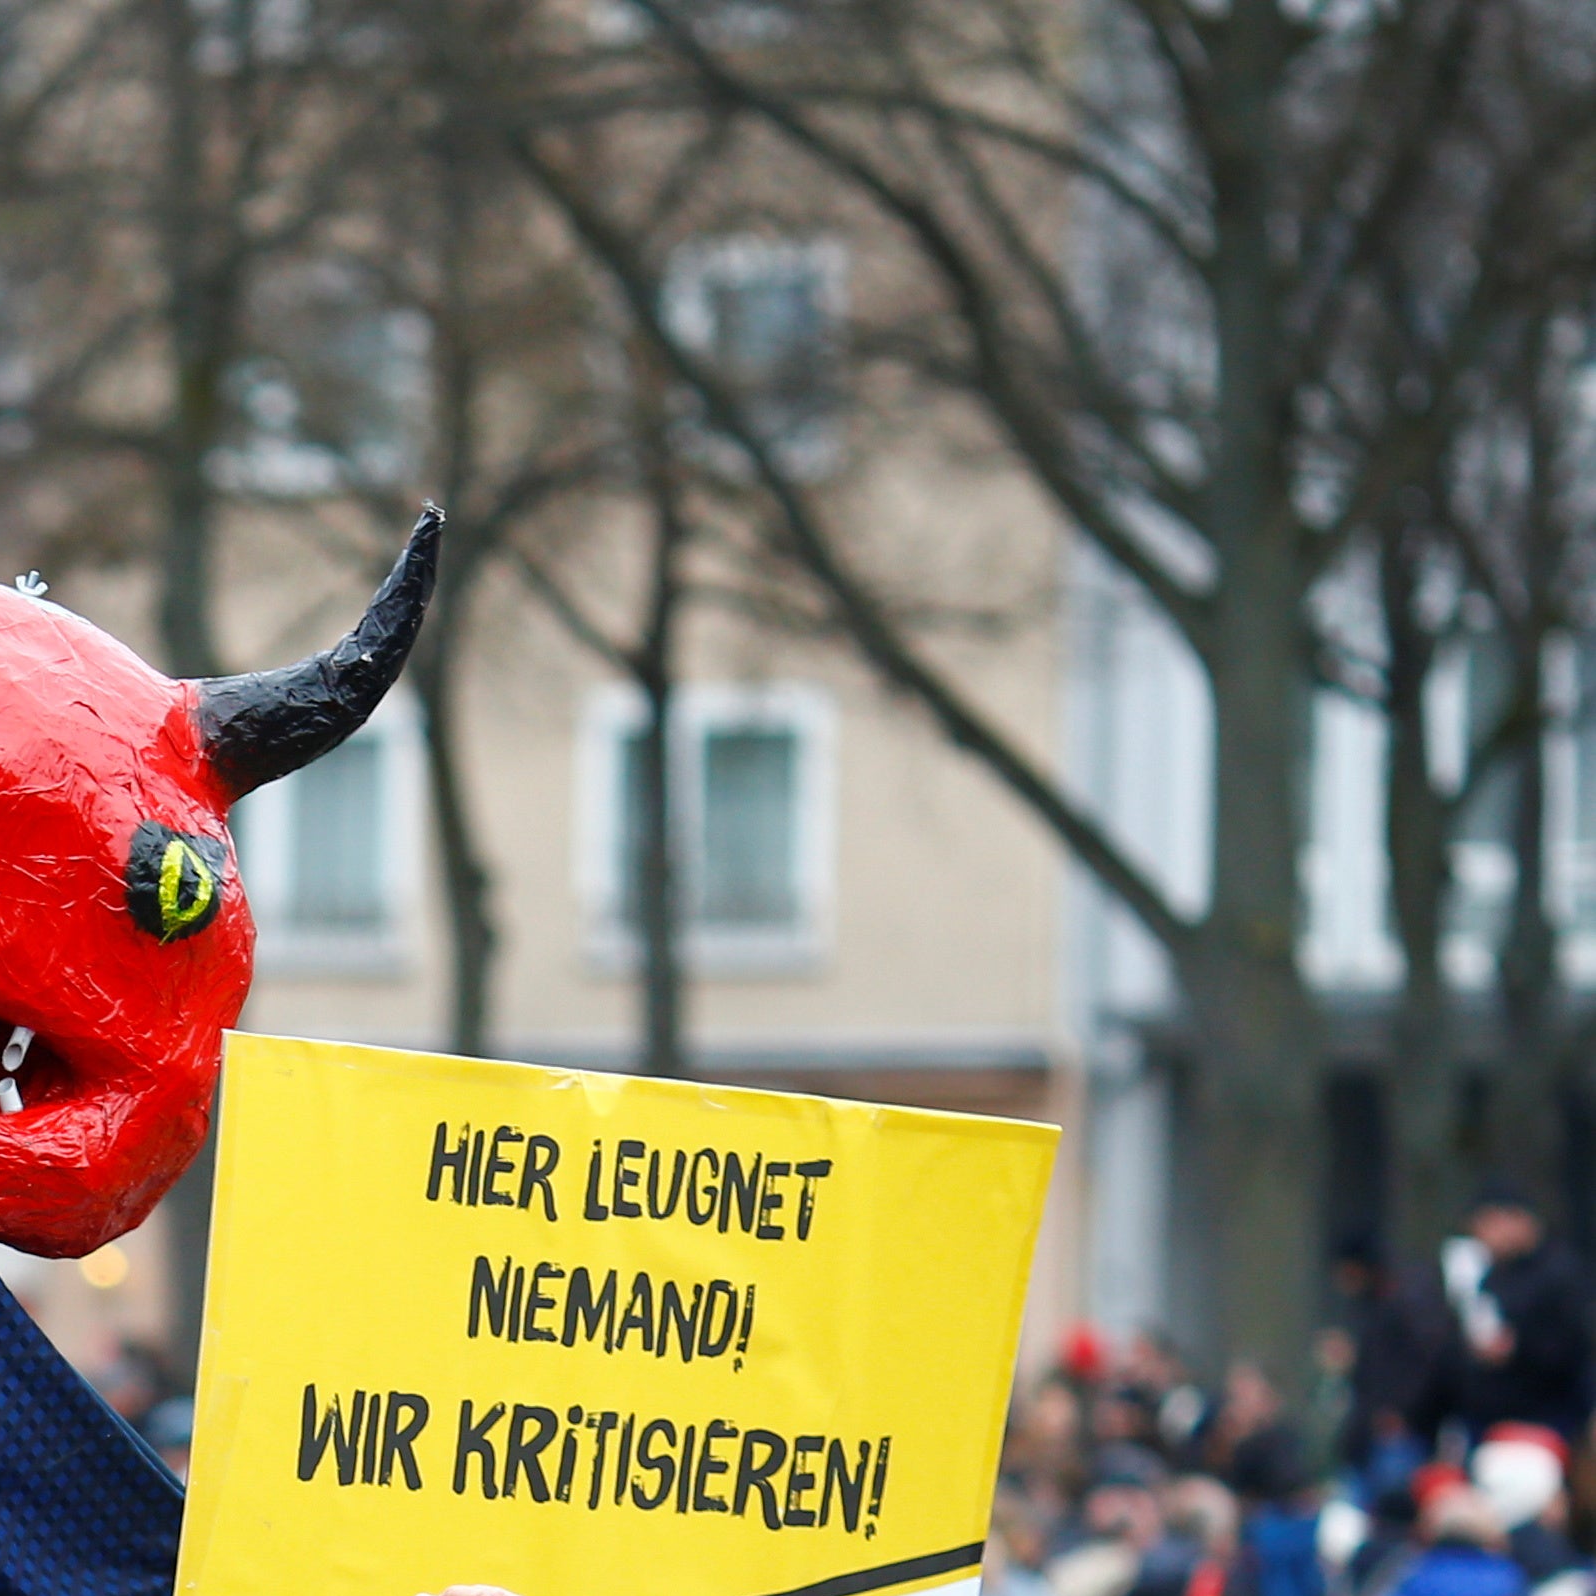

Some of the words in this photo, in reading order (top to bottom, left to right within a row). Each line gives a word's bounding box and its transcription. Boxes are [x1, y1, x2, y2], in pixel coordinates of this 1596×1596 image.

[427, 1122, 559, 1221] HIER
[584, 1139, 833, 1241] LEUGNET
[468, 1256, 755, 1372] NIEMAND!
[298, 1384, 429, 1490] WIR
